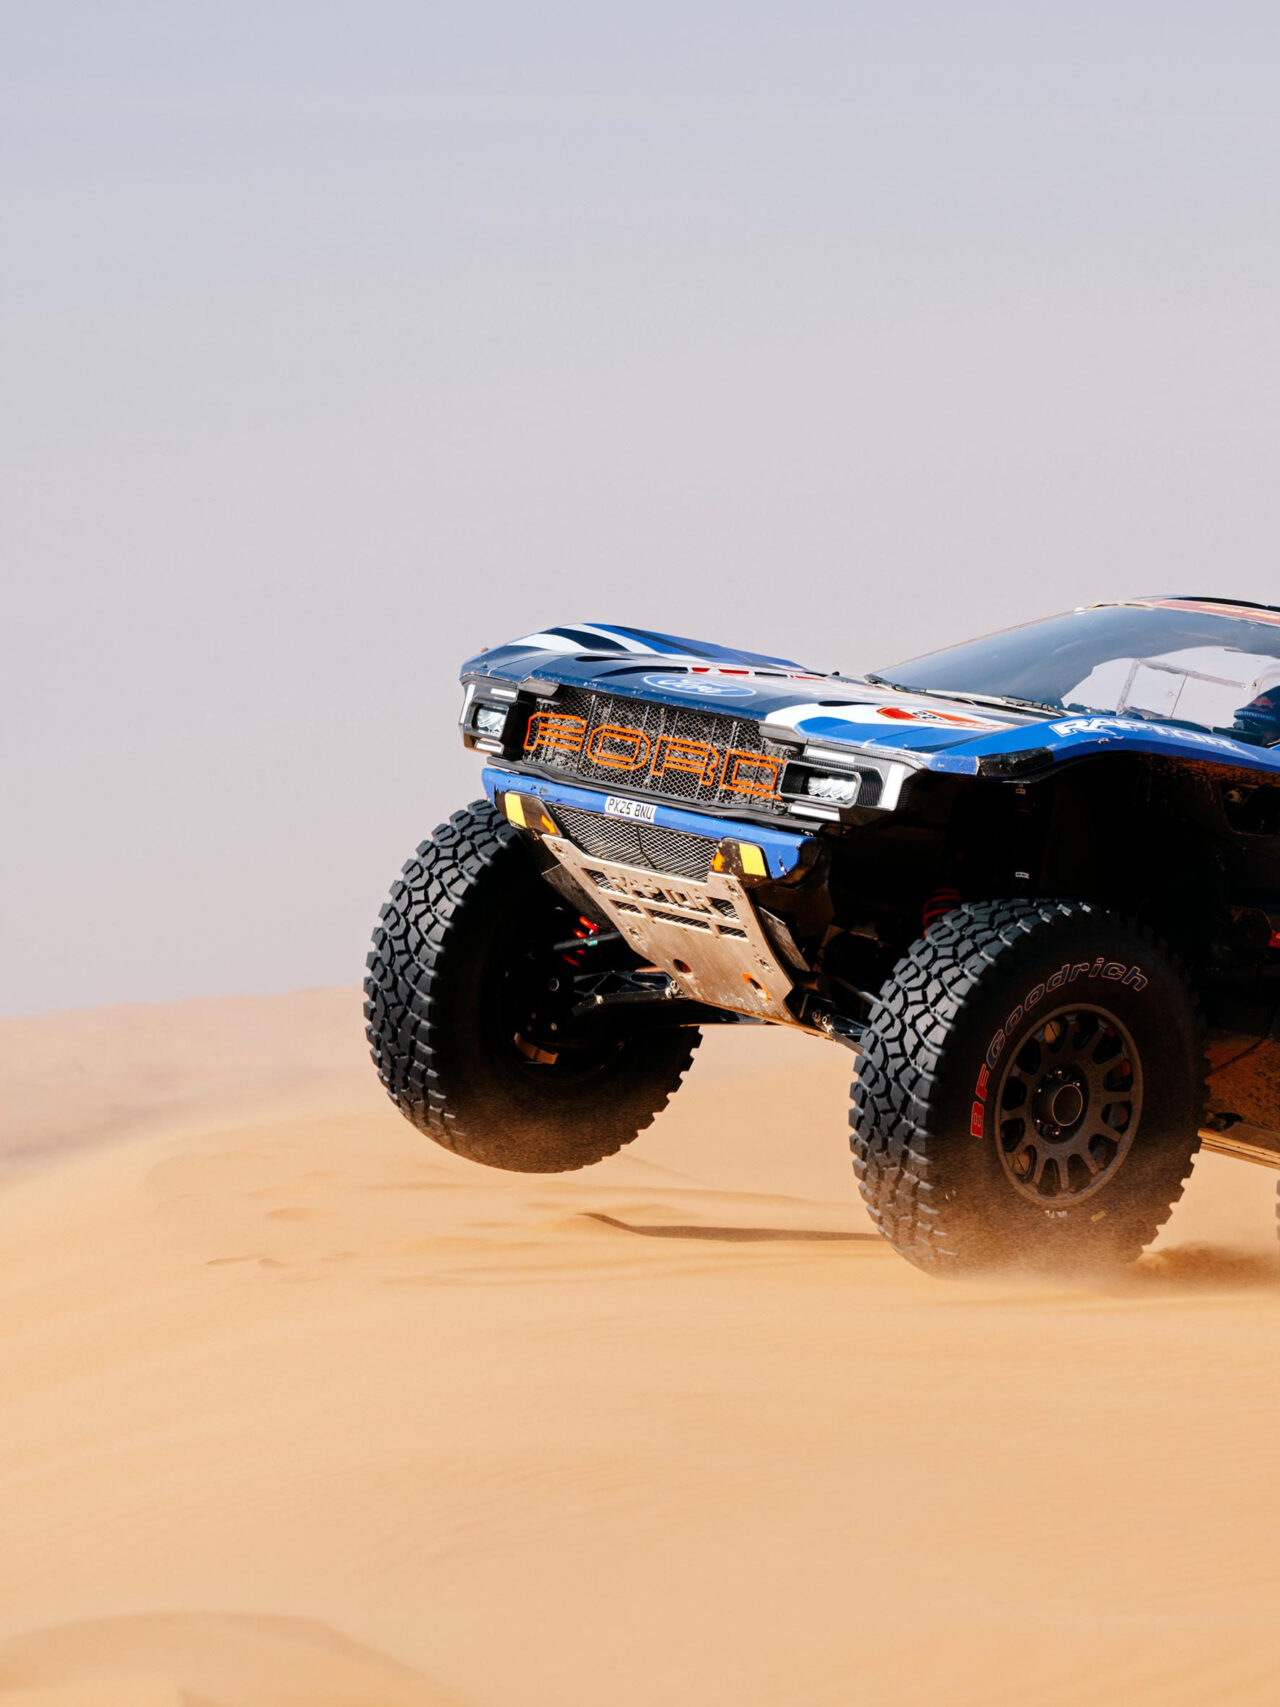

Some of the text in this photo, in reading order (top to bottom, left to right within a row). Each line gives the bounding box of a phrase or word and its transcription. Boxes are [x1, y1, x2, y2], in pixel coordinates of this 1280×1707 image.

[524, 712, 785, 800] FORD
[1050, 717, 1259, 760] RAPTOR
[607, 798, 653, 820] PX25 BNU
[970, 957, 1148, 1138] BFGoodrich
